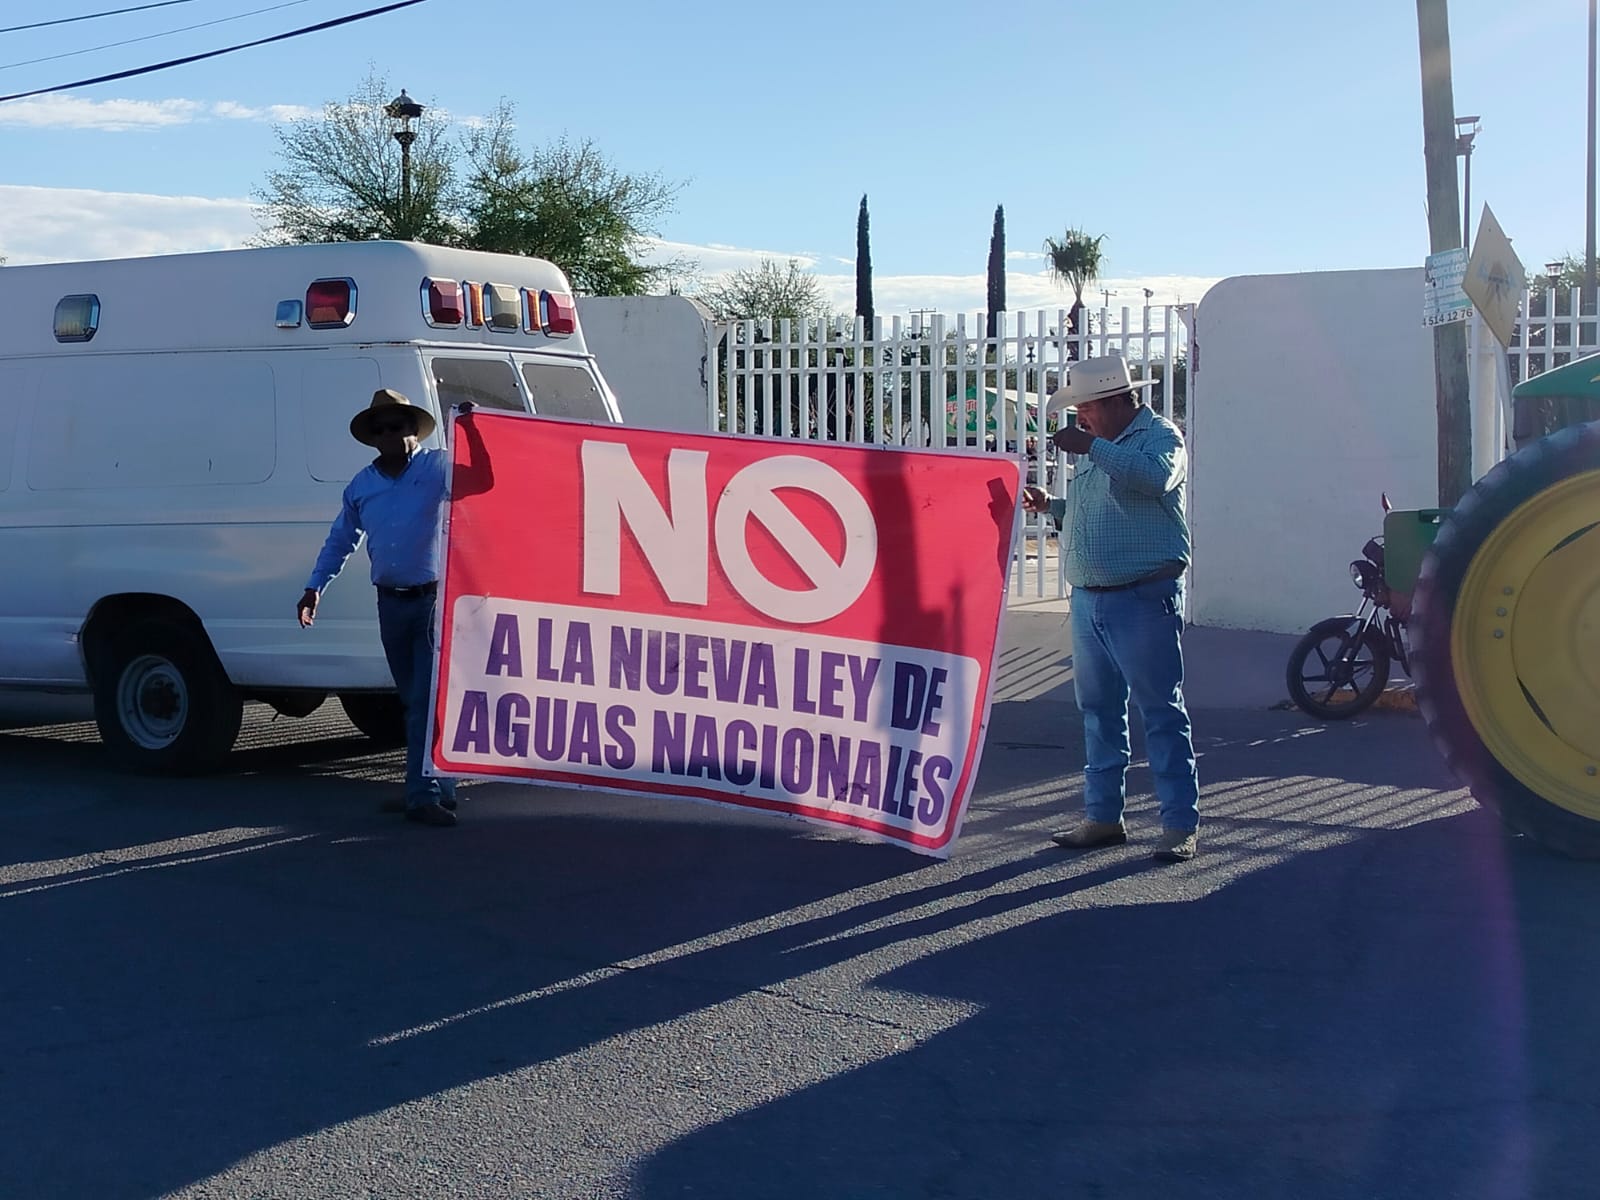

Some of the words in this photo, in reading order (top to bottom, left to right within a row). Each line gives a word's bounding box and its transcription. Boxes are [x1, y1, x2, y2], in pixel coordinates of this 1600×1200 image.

[1428, 313, 1444, 326] 514
[1447, 310, 1458, 322] 12
[1460, 307, 1473, 319] 76
[581, 440, 878, 623] NO
[485, 613, 523, 678] A
[537, 618, 595, 686] LA
[609, 625, 779, 709] NUEVA
[793, 647, 881, 722] LEY
[891, 661, 948, 737] DE
[452, 690, 636, 770] AGUAS
[652, 710, 953, 826] NACIONALES
